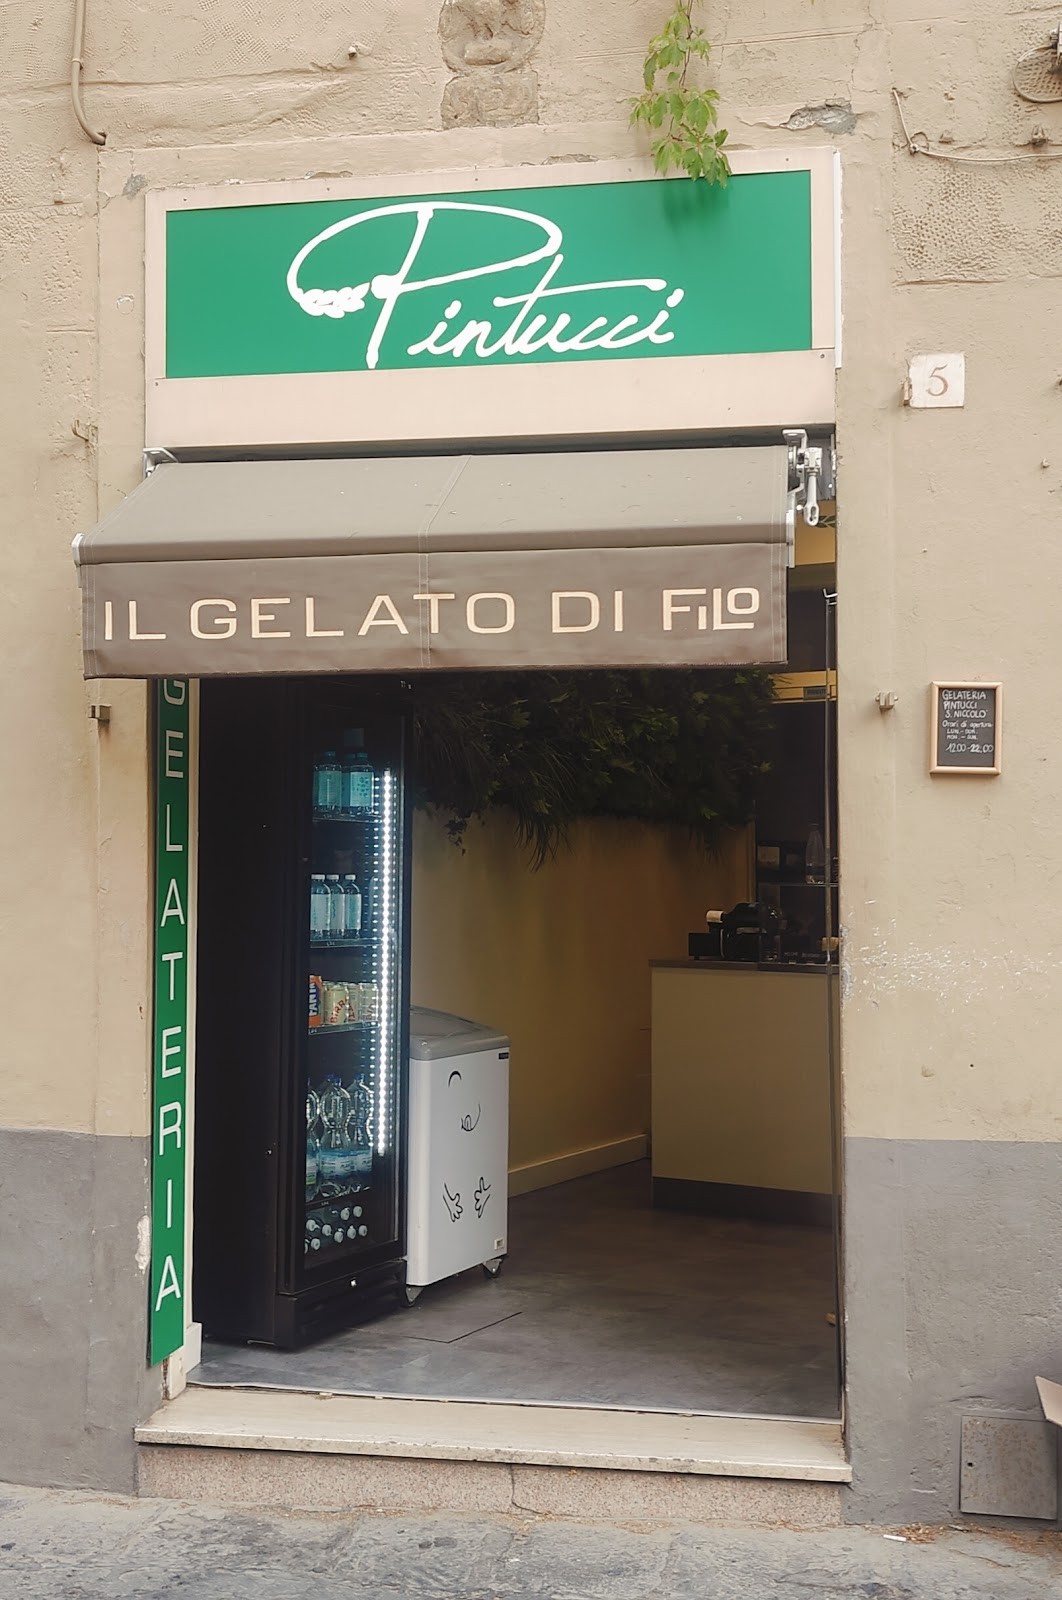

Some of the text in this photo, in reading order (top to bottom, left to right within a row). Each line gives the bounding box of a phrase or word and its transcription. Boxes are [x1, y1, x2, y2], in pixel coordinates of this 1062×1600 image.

[287, 201, 685, 369] Pintucci
[927, 364, 949, 397] 5
[105, 600, 167, 641] IL
[189, 590, 517, 641] GELATO
[551, 590, 624, 634] DI
[942, 689, 986, 700] GELATERIA
[943, 701, 978, 710] PINTUCCI
[945, 710, 953, 718] S.
[155, 678, 187, 1313] GELATERIA
